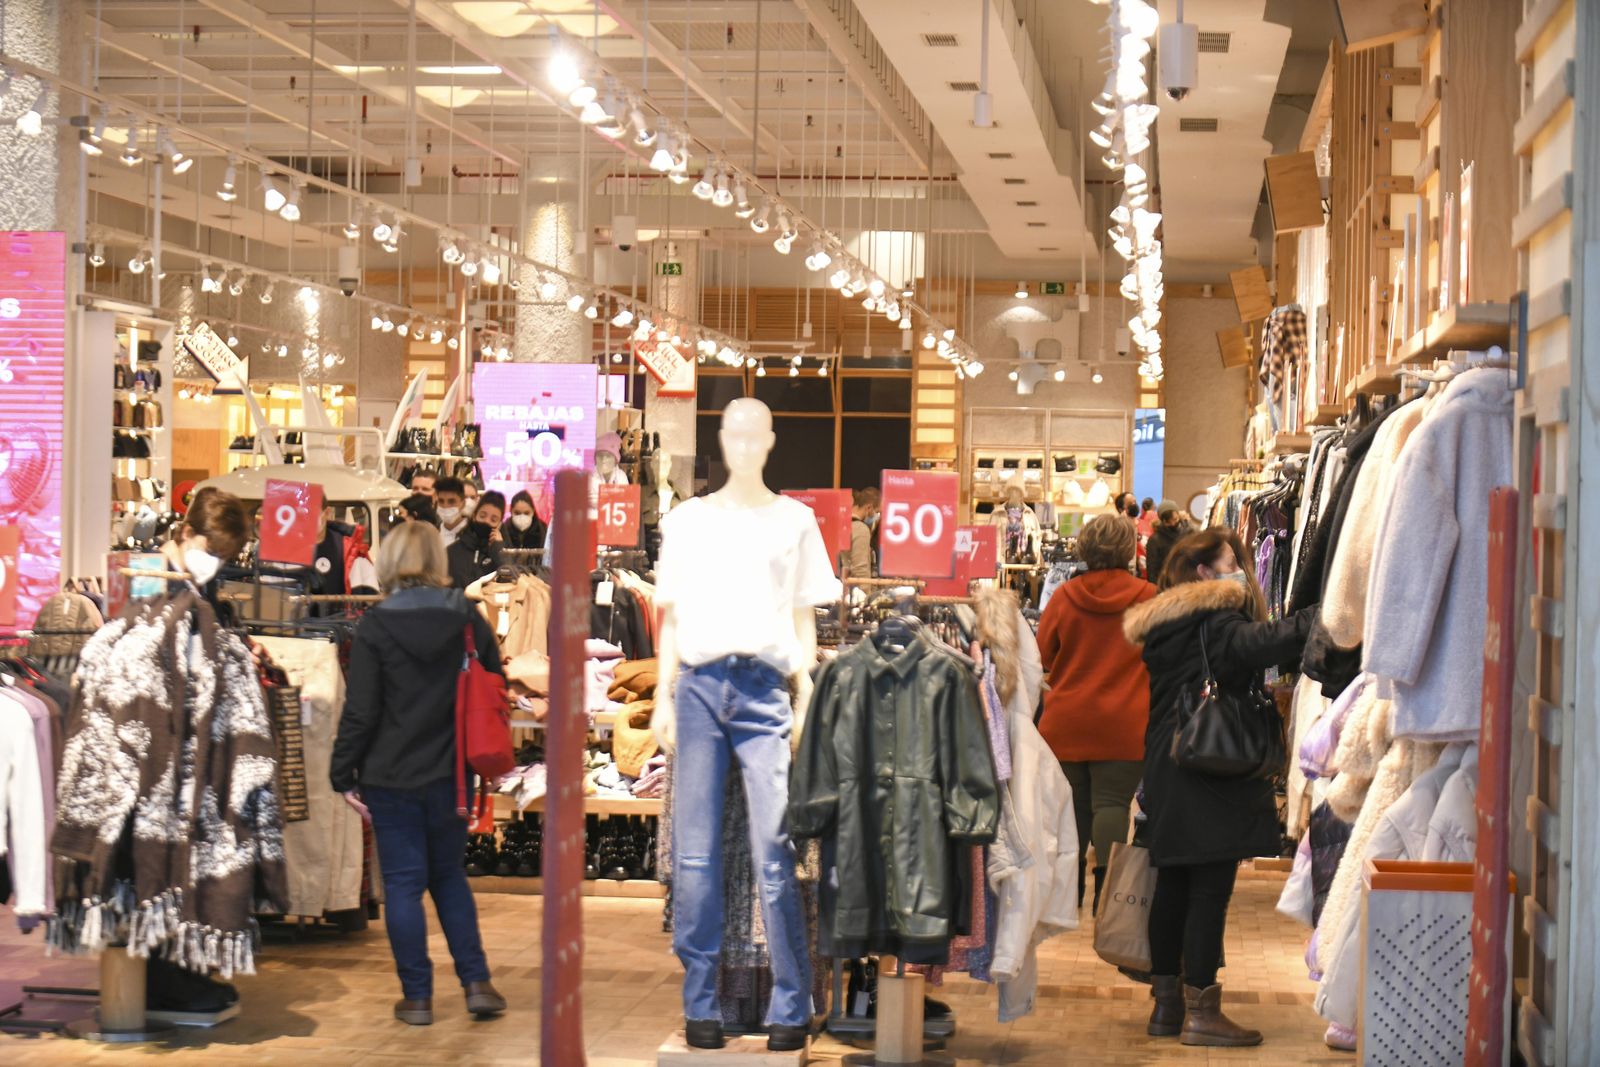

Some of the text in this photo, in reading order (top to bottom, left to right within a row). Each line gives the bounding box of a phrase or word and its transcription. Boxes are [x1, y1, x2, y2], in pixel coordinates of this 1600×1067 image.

[485, 405, 584, 420] REBAJAS
[519, 421, 550, 430] HASTA
[888, 475, 915, 486] Hasta
[276, 505, 296, 536] 9
